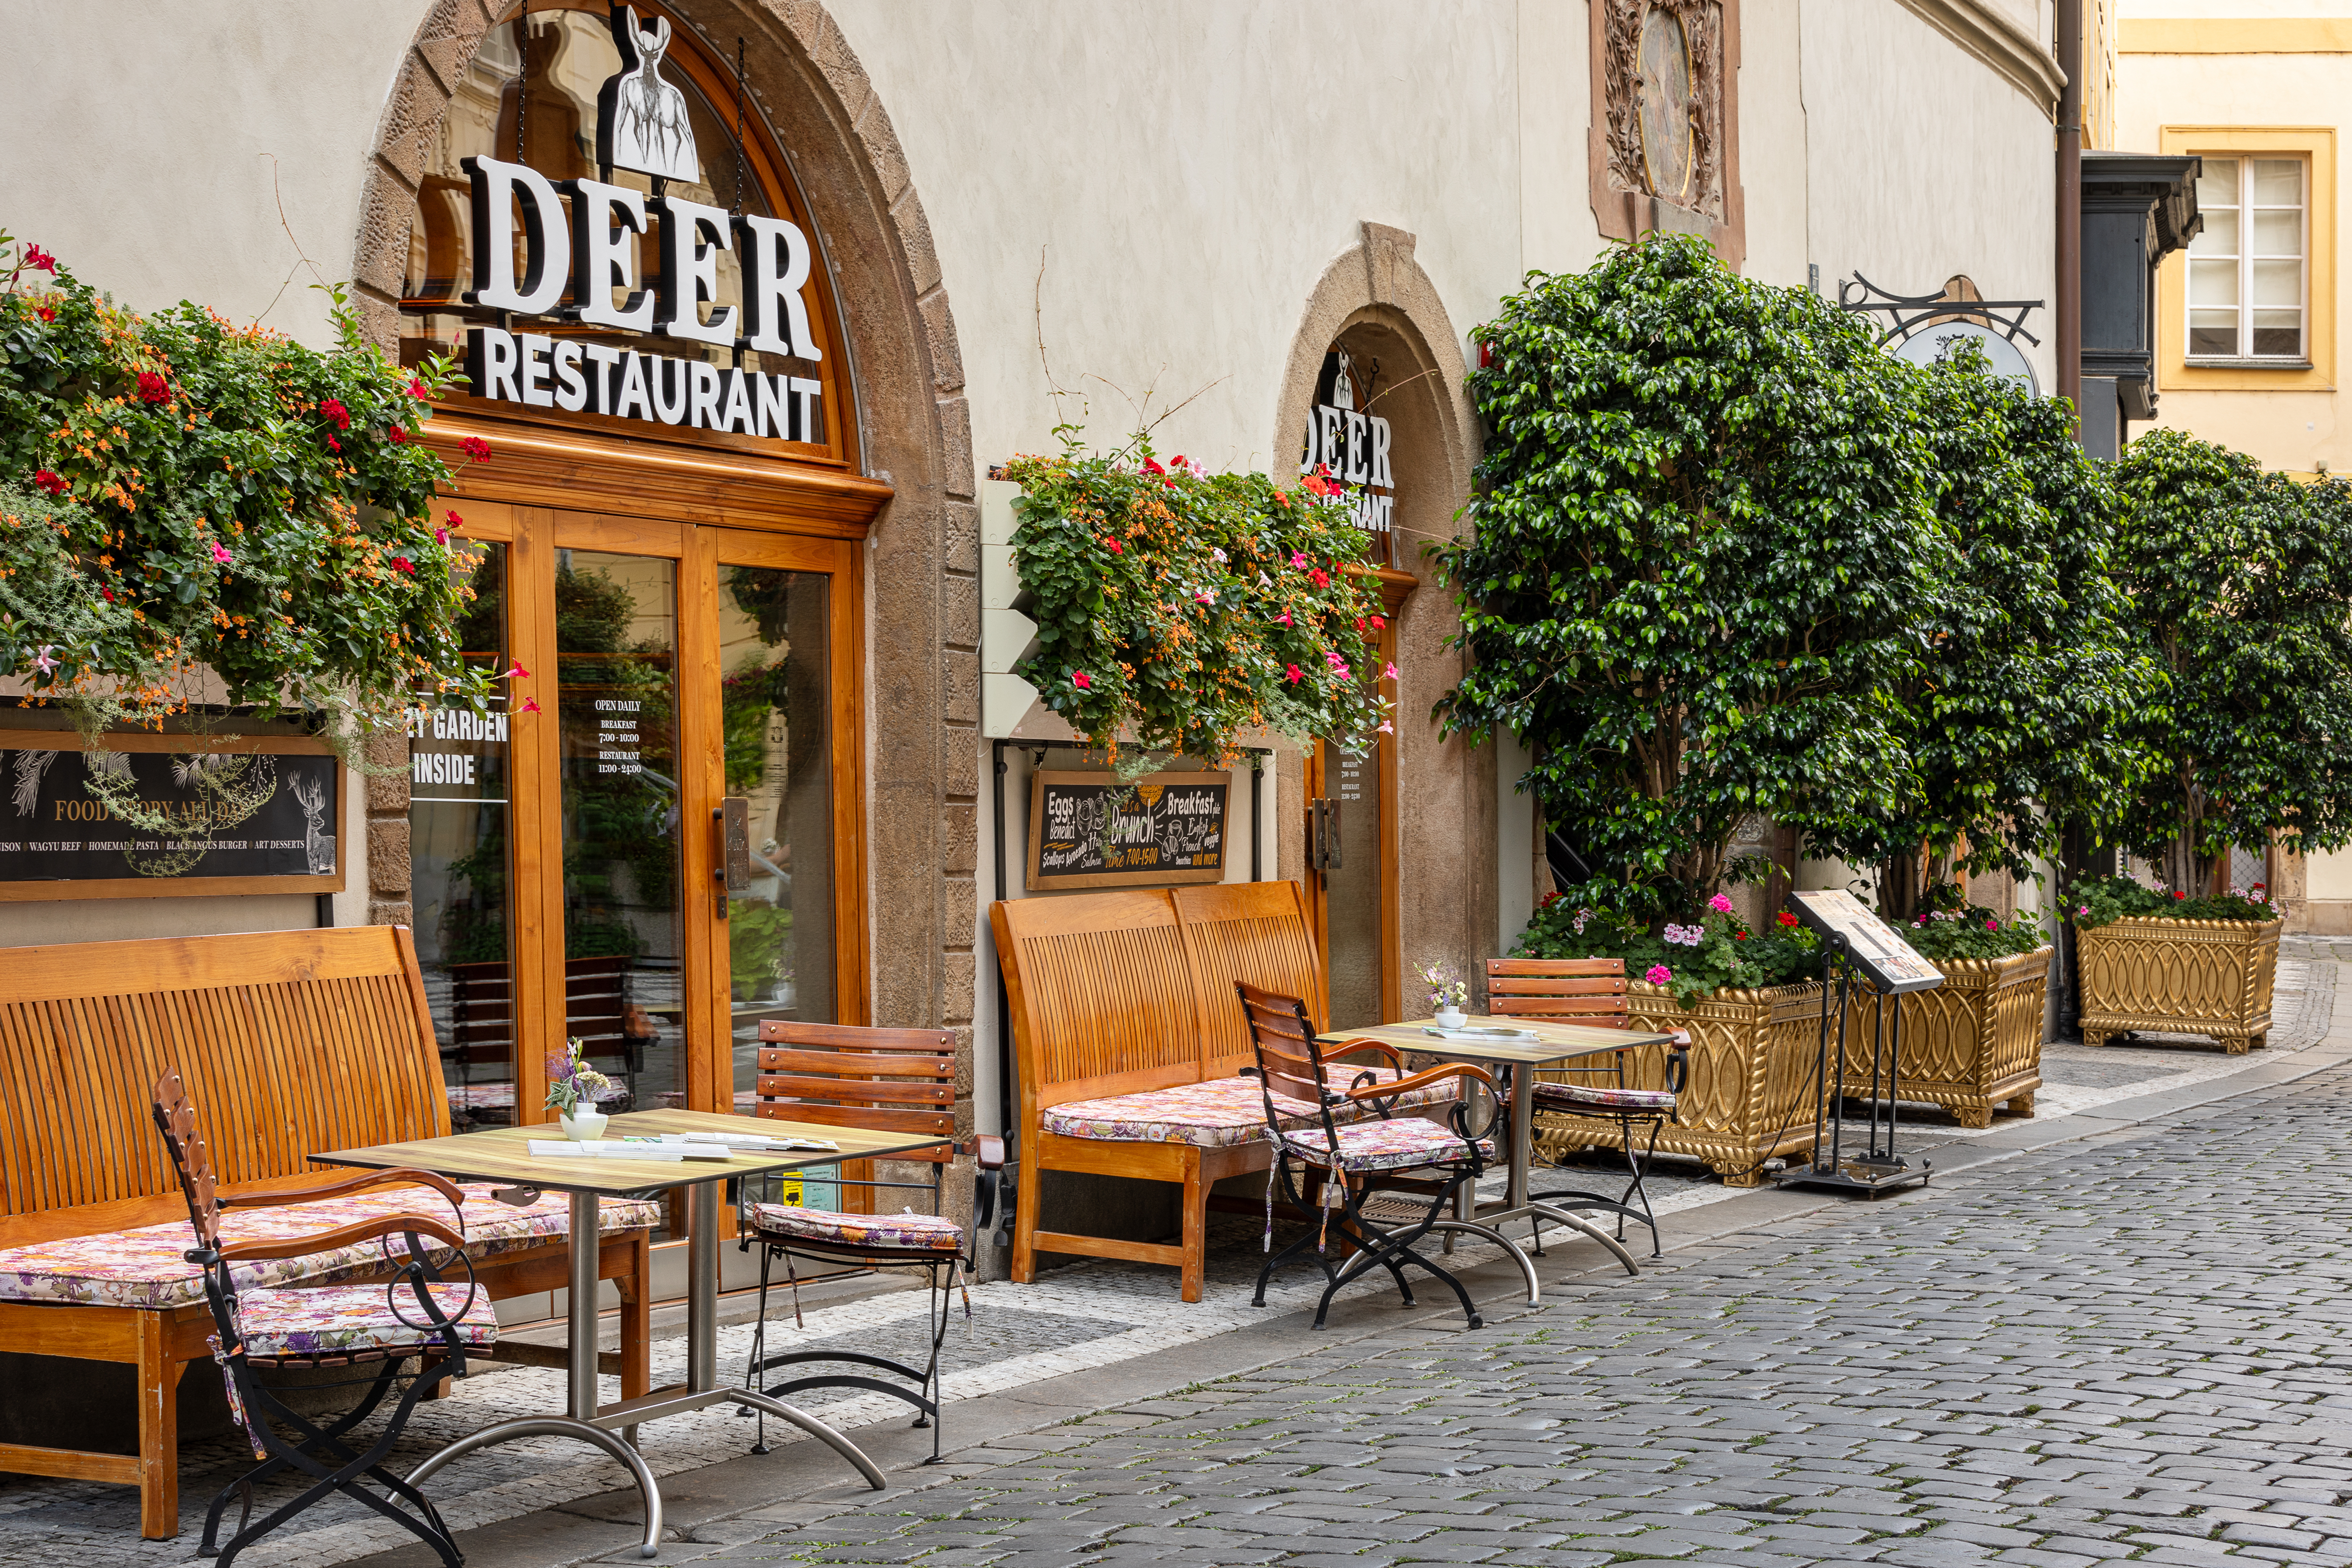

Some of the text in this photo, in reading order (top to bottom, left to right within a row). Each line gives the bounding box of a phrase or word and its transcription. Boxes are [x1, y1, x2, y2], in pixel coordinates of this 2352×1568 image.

[476, 154, 822, 361] DEER
[484, 328, 821, 444] RESTAURANT
[596, 700, 641, 711] OPEN DAILY
[433, 709, 507, 742] GARDEN
[601, 720, 636, 729] BREAKFAST
[599, 733, 615, 743] 7:00
[599, 751, 640, 760] RESTAURANT
[414, 753, 475, 785] INSIDE
[621, 764, 641, 775] 24:00
[55, 800, 109, 821] FOOD
[179, 801, 211, 820] ALL
[1049, 792, 1073, 823] Eggs
[1120, 795, 1134, 813] Its
[1168, 791, 1214, 815] Breakfast
[1050, 817, 1075, 840] Benedict
[1111, 798, 1154, 844] Brunch
[1187, 816, 1208, 840] English
[0, 842, 21, 852] ISON
[29, 842, 60, 852] WAGYU
[61, 842, 81, 851] BEEF
[88, 841, 135, 851] HOMEMADE
[136, 841, 159, 850] PASTA
[218, 840, 247, 850] BURGER
[254, 840, 269, 849] ART
[270, 840, 305, 849] DESSERTS
[1181, 836, 1201, 852] French
[1204, 831, 1219, 849] veggie
[1043, 851, 1065, 869] Scallops
[1066, 841, 1087, 867] Avocado
[1081, 853, 1103, 868] Salmon
[1176, 856, 1191, 865] Smoothies
[1193, 847, 1218, 866] and more
